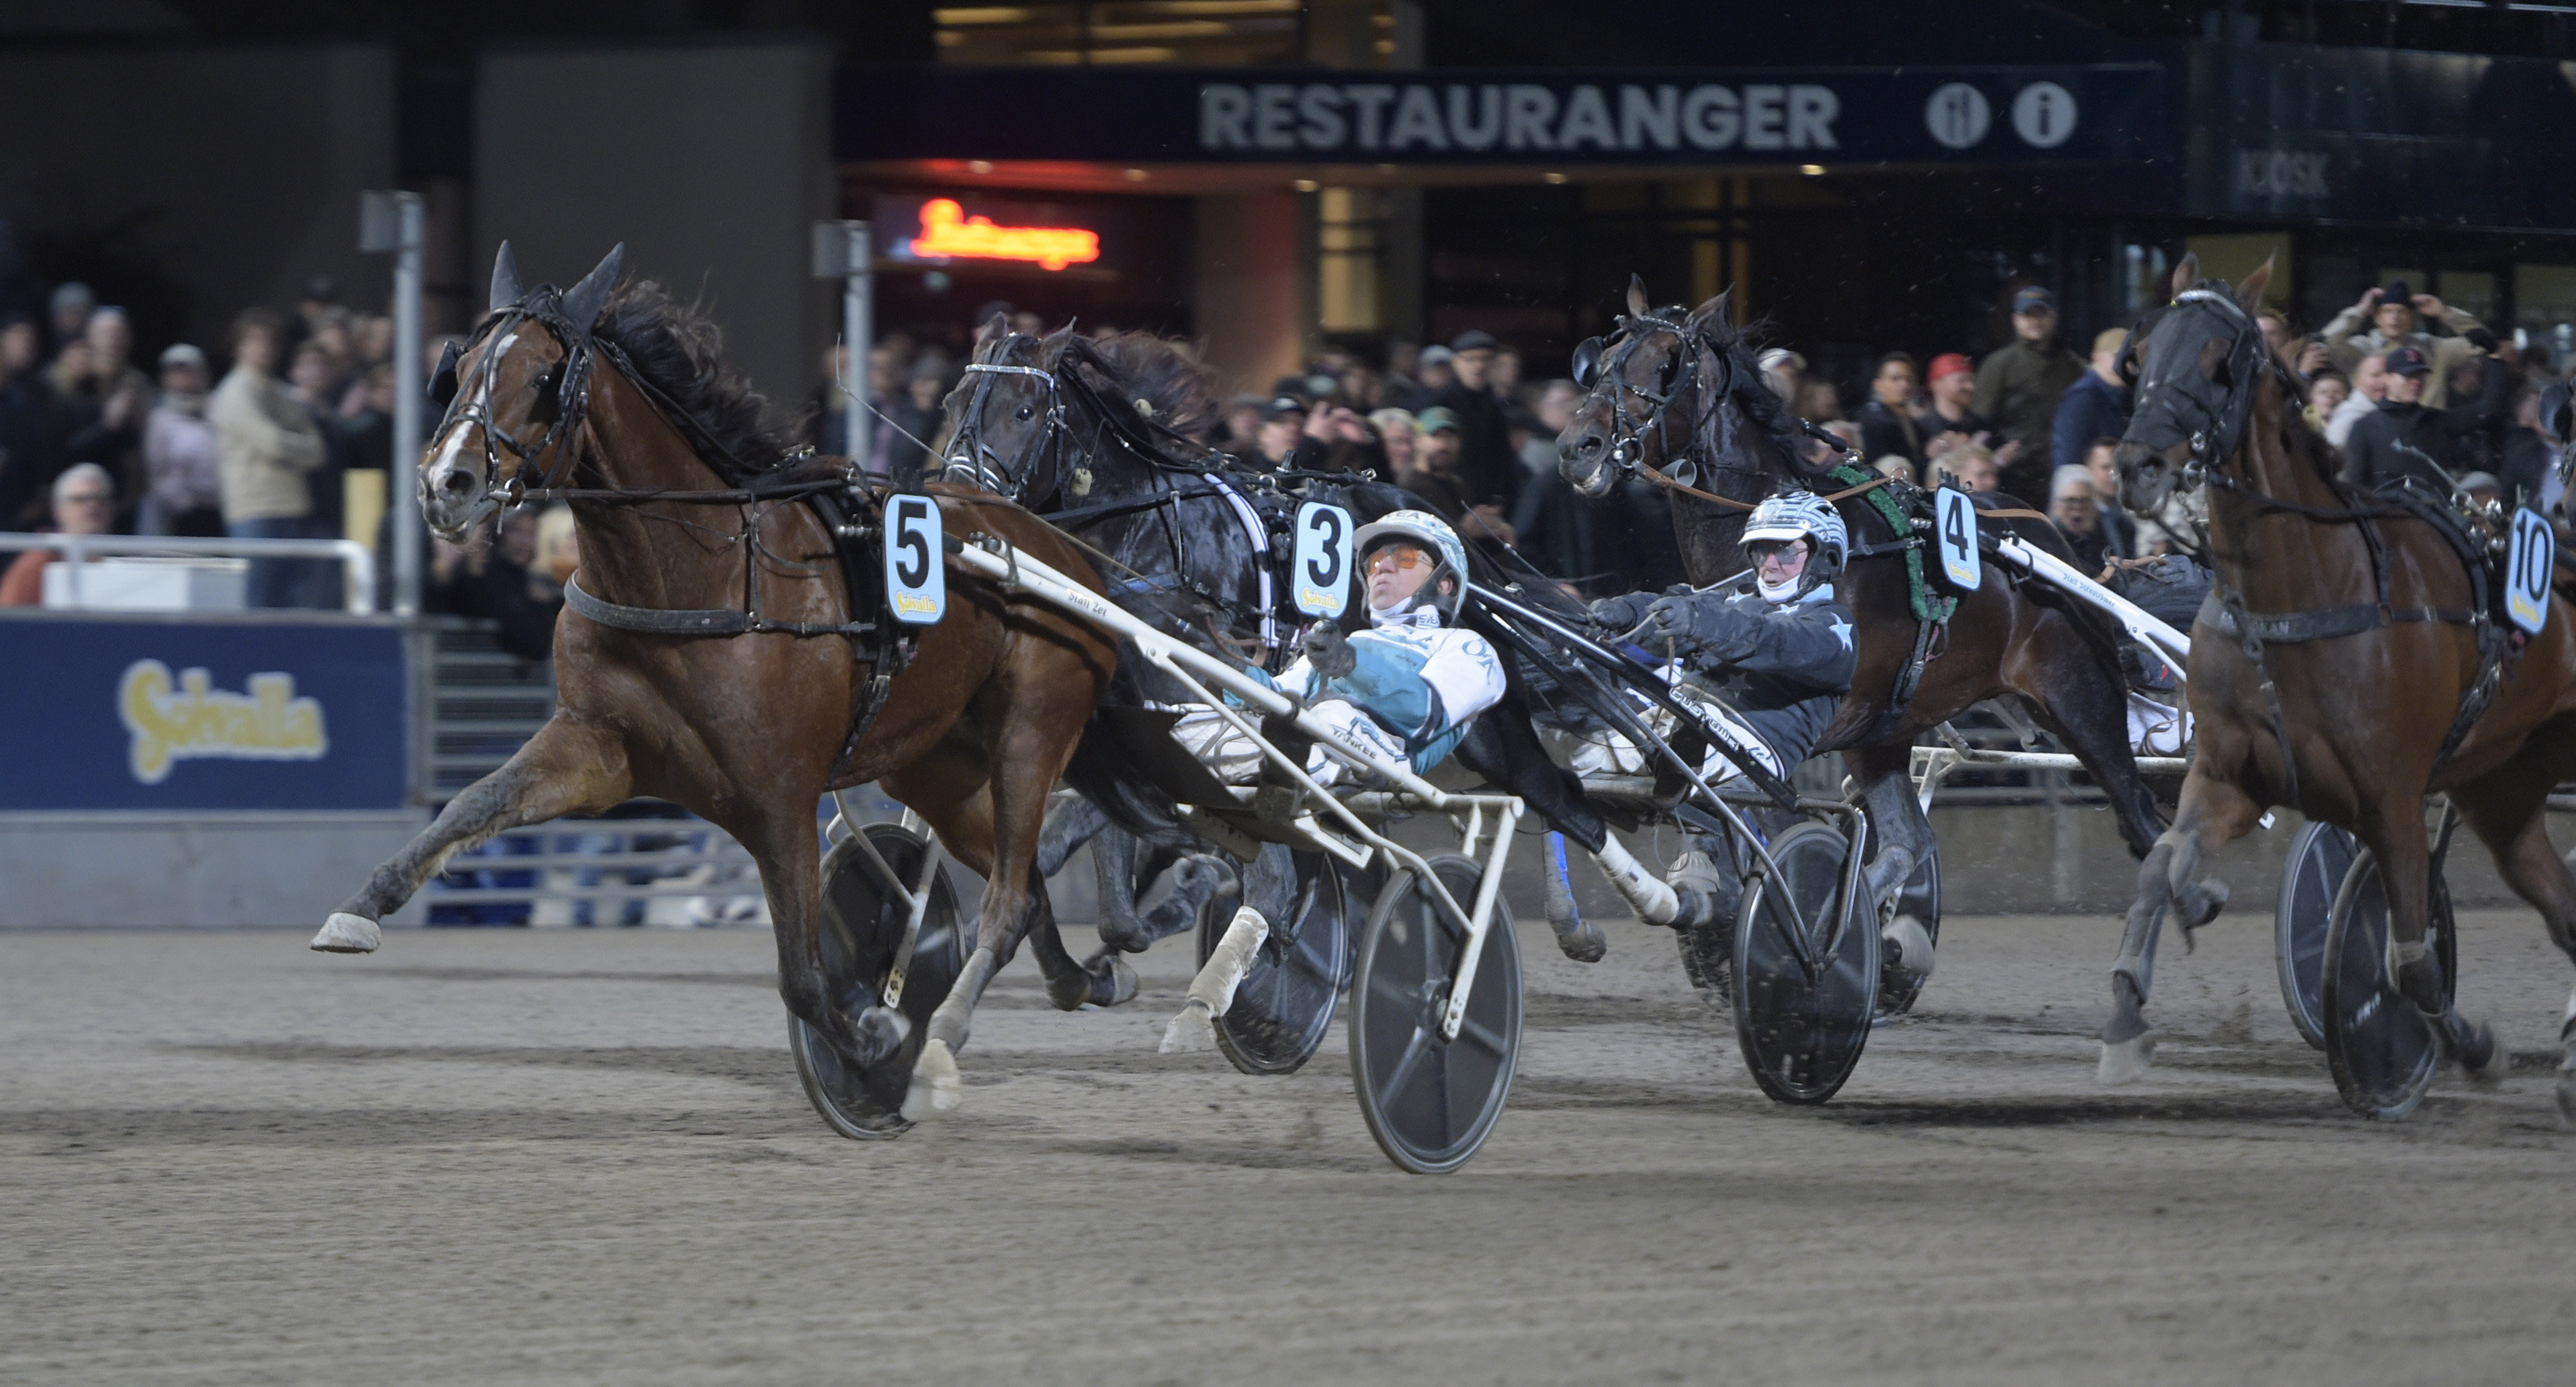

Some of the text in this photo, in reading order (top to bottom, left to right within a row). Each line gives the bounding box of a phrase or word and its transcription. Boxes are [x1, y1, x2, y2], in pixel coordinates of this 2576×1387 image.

[1202, 83, 1838, 150] RESTAURANGER
[895, 500, 929, 589] 5
[1307, 507, 1341, 587] 3
[1946, 494, 1969, 562] 4
[2515, 510, 2551, 601] 10
[1333, 727, 1377, 759] YANKEE
